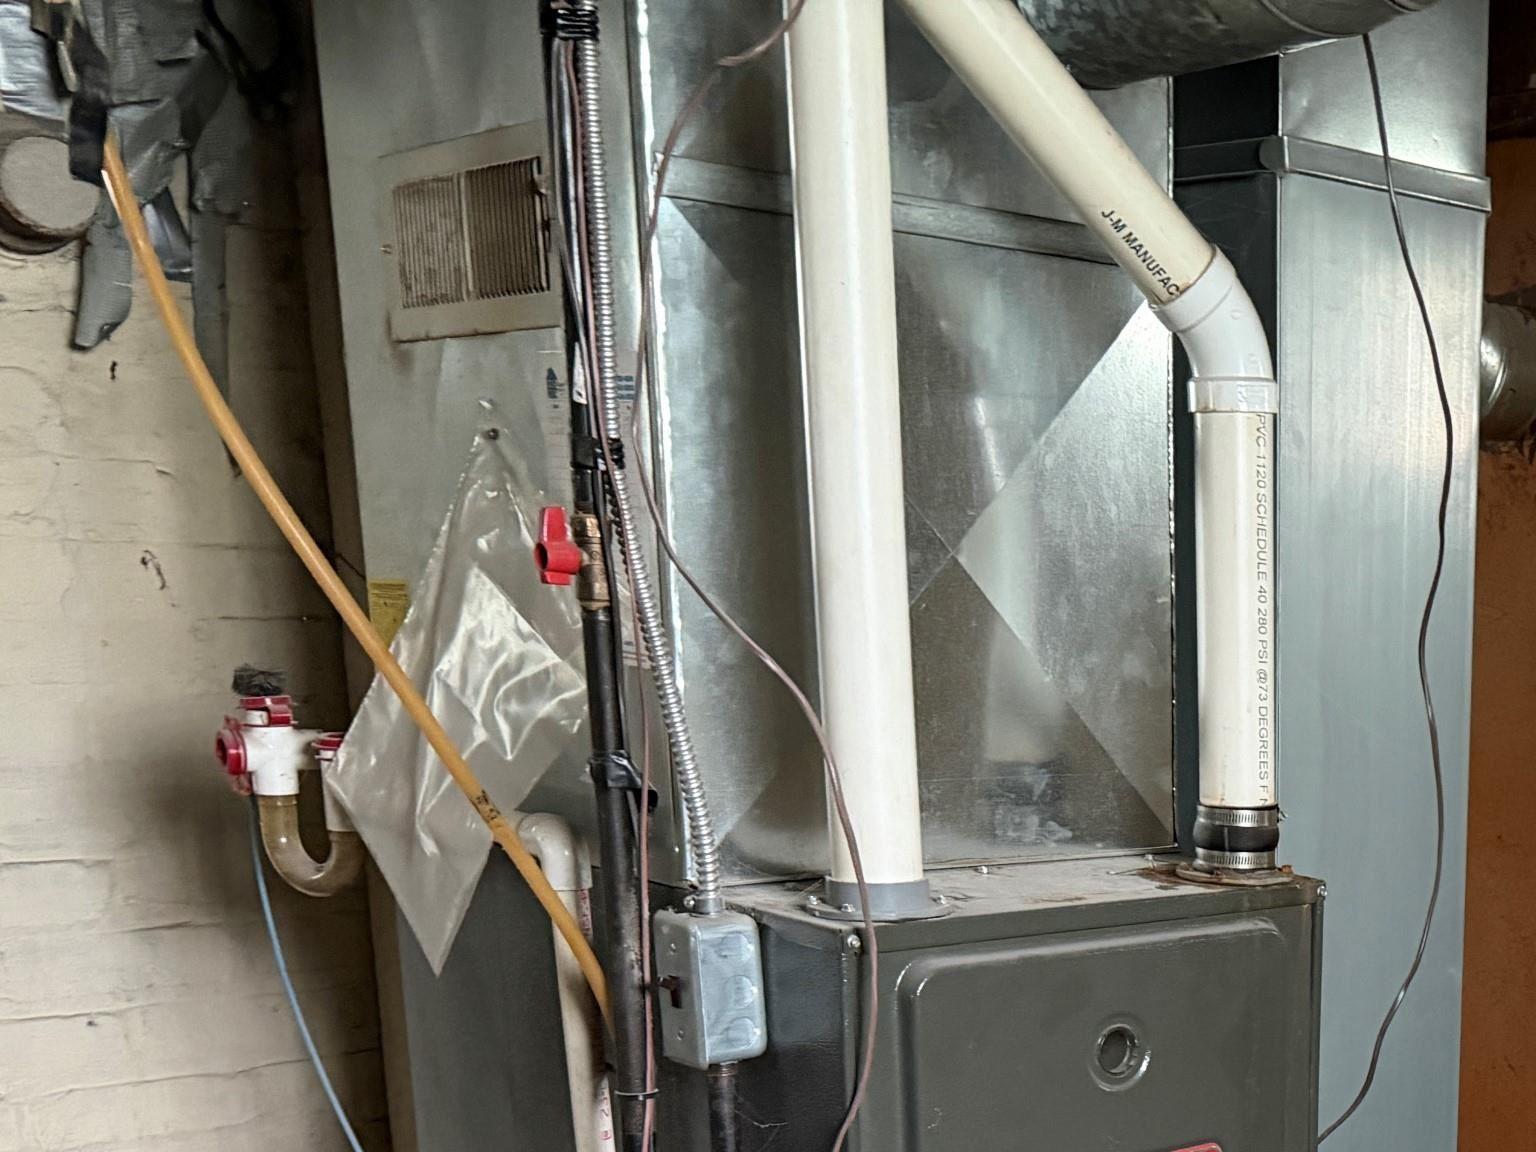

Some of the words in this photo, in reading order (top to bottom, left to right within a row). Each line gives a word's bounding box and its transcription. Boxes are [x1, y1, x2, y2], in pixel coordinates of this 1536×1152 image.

[1100, 209, 1127, 233] J-M
[1256, 414, 1267, 448] PVC
[1256, 455, 1267, 489] 1120
[1256, 493, 1268, 581] SCHEDULE
[1257, 585, 1268, 604] 40
[1257, 608, 1268, 635] 280
[1257, 639, 1268, 664] PSI
[1258, 706, 1269, 780] DEGREES
